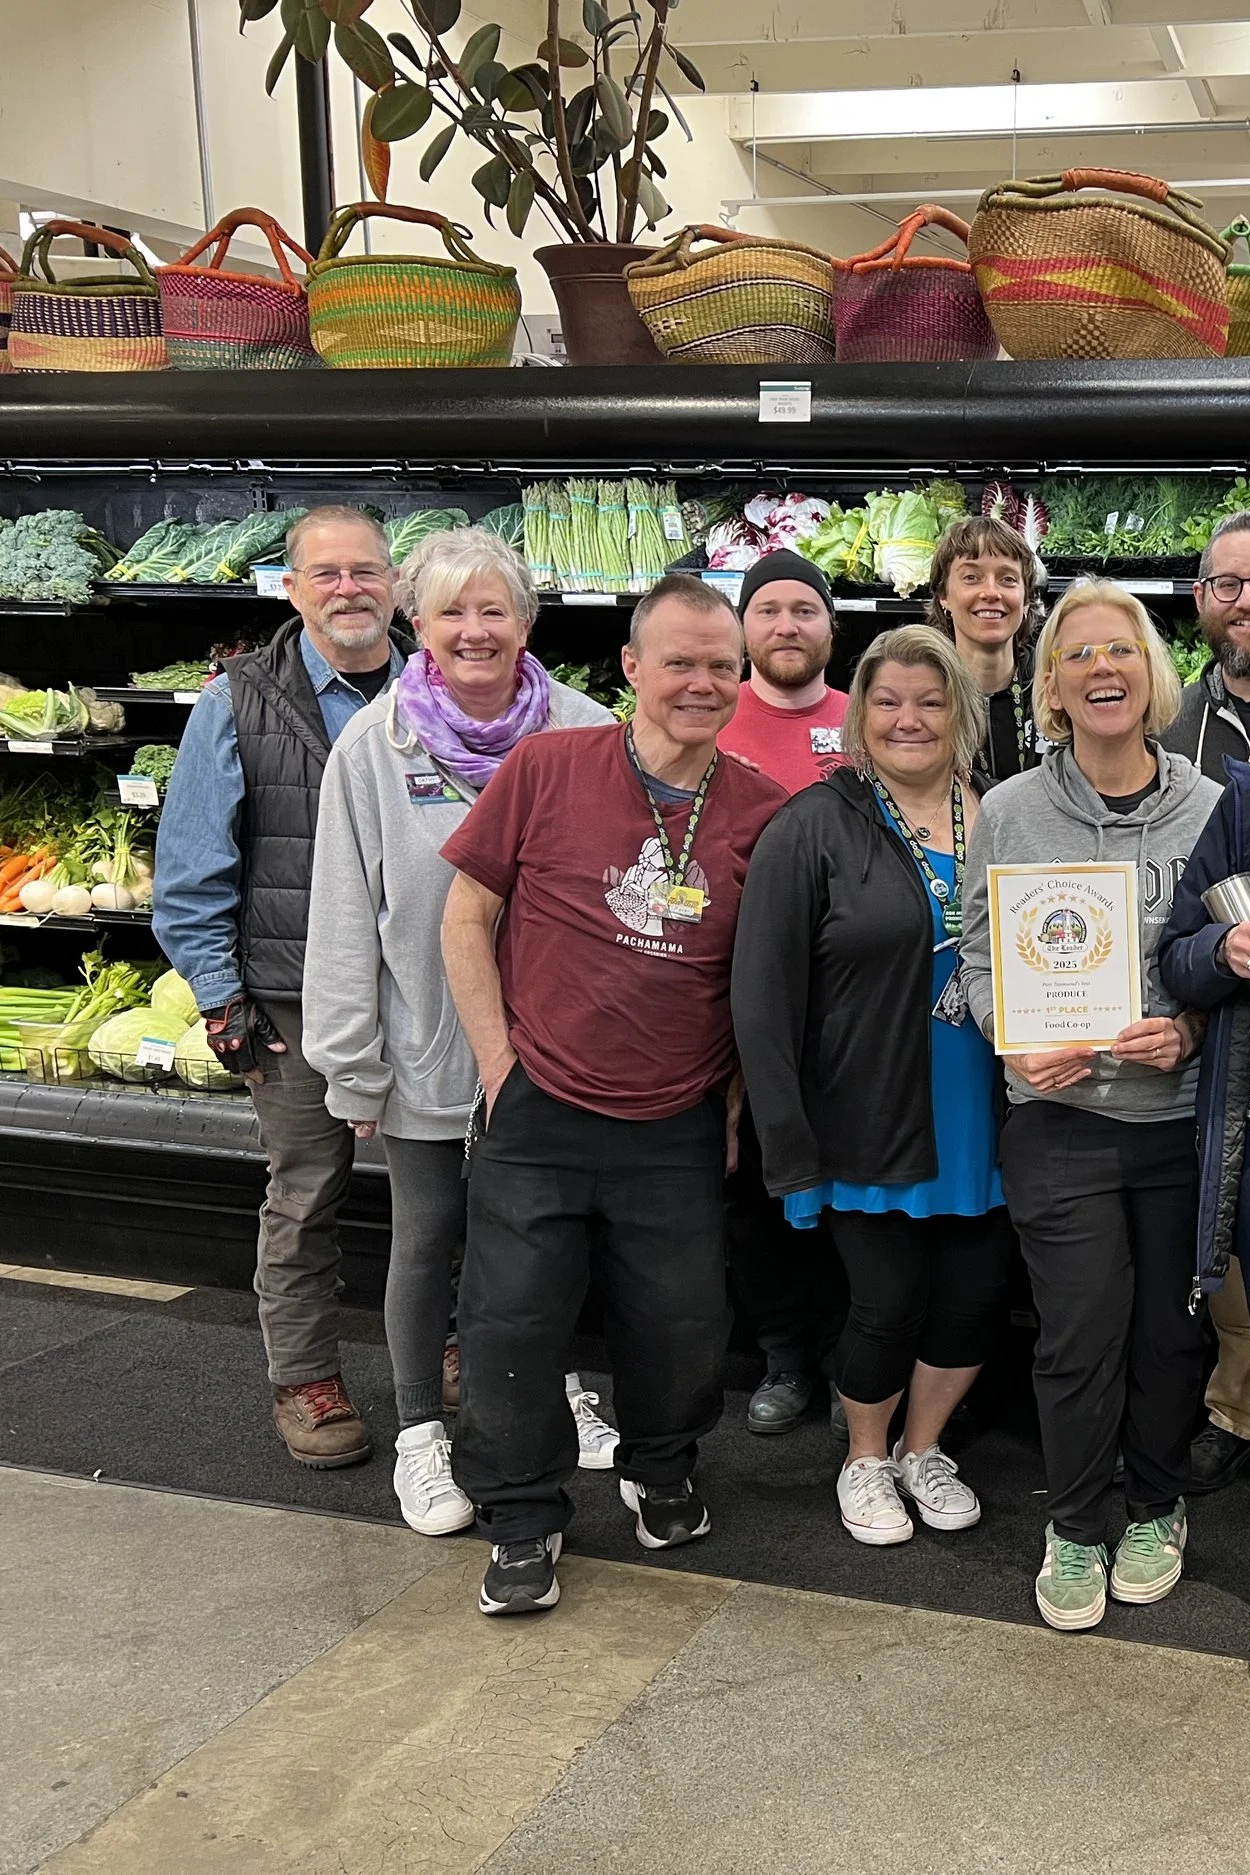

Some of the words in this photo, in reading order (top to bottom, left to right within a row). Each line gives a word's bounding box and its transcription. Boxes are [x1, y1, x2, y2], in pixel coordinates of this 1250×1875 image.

[773, 406, 797, 415] $49.99
[1008, 882, 1045, 916] Readers'
[1047, 879, 1083, 891] Choice
[1083, 884, 1116, 912] Awards
[615, 933, 684, 954] PACHAMAMA
[1053, 960, 1078, 969] 2025
[1046, 990, 1088, 999] PRODUCE
[1058, 1005, 1089, 1014] PLACE
[1044, 1020, 1066, 1029] Food
[1066, 1020, 1092, 1031] Co-op
